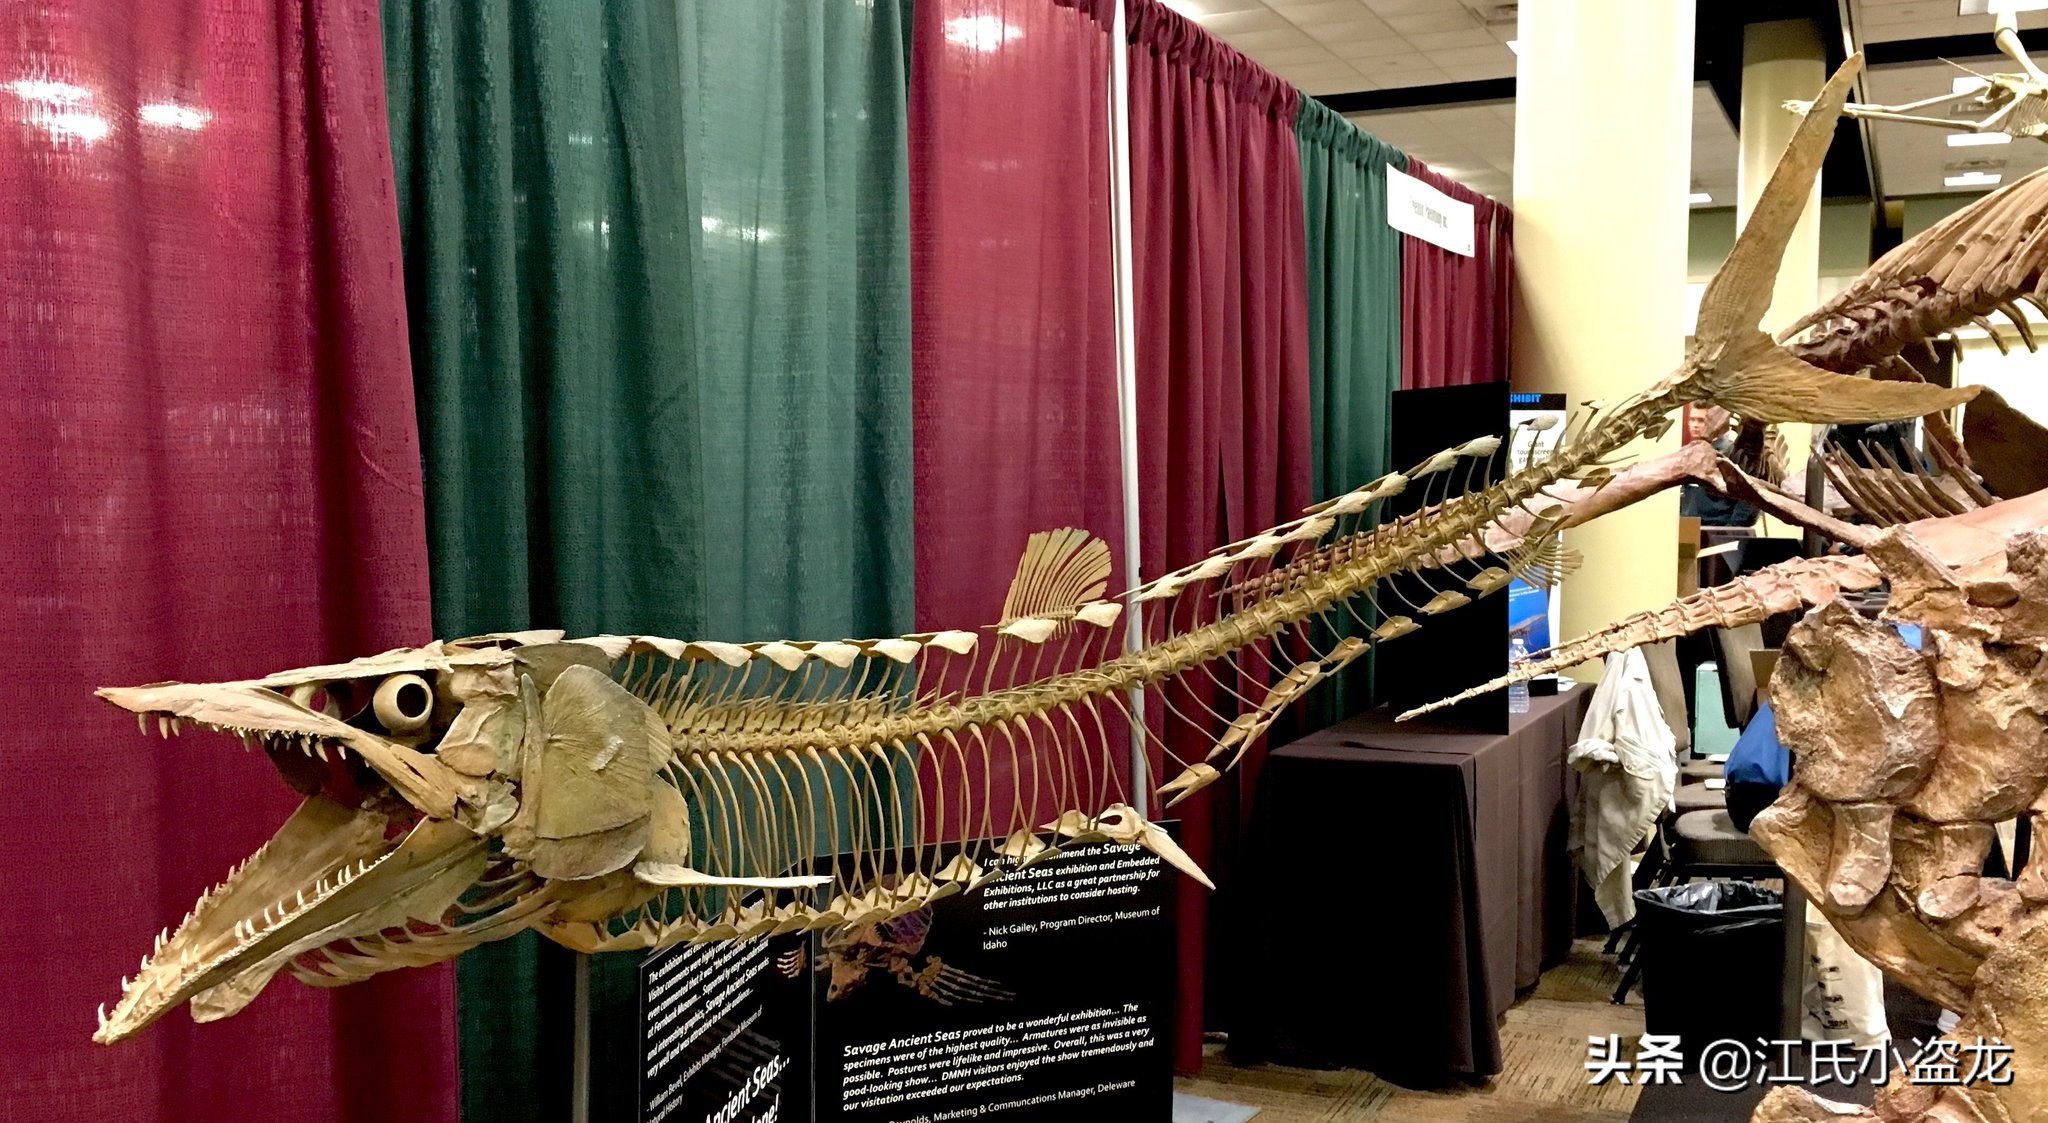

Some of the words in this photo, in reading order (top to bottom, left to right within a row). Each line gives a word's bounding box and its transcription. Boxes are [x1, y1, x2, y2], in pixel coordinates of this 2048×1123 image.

[984, 858, 988, 867] I
[1087, 846, 1101, 856] the
[1027, 868, 1053, 879] Seas
[1055, 863, 1097, 875] exhibition
[1099, 860, 1115, 871] and
[1116, 856, 1160, 869] Embedded
[983, 884, 1034, 898] Exhibitions,
[1036, 882, 1054, 891] LLC
[1055, 880, 1066, 888] as
[1066, 879, 1073, 888] a
[1073, 876, 1097, 889] great
[1097, 872, 1147, 886] partnership
[1146, 869, 1160, 881] for
[983, 901, 1008, 911] other
[1008, 894, 1058, 907] institutions
[1059, 893, 1069, 901] to
[1070, 889, 1106, 900] consider
[1107, 884, 1140, 896] hosting.
[988, 926, 1008, 936] Nick
[1009, 923, 1038, 934] Gailey,
[1040, 918, 1077, 931] Program
[1078, 914, 1113, 925] Director,
[1115, 910, 1150, 920] Museum
[1151, 906, 1161, 916] of
[649, 971, 658, 985] The
[659, 955, 682, 978] exhibition
[683, 948, 692, 960] was
[983, 939, 1008, 950] Idaho
[648, 985, 665, 1003] Visitor
[665, 966, 690, 990] comments
[690, 957, 701, 972] were
[702, 946, 716, 964] highly
[648, 1005, 661, 1021] even
[660, 980, 689, 1011] commented
[688, 974, 699, 990] that
[704, 966, 713, 978] was
[723, 950, 733, 964] best
[647, 1025, 654, 1039] at
[654, 1007, 678, 1034] Fernbank
[702, 969, 725, 996] Supported
[724, 967, 731, 980] by
[647, 1043, 658, 1061] and
[658, 1025, 684, 1052] interesting
[705, 990, 726, 1014] Savage
[725, 973, 746, 997] Ancient
[745, 965, 758, 982] Seas
[758, 955, 769, 972] works
[647, 1063, 658, 1079] very
[659, 1050, 670, 1069] well
[670, 1042, 680, 1060] and
[680, 1037, 690, 1051] was
[690, 1019, 712, 1043] attractive
[721, 1002, 732, 1017] wide
[843, 1041, 887, 1057] Savage
[888, 1034, 933, 1050] Ancient
[934, 1030, 961, 1043] Seas
[962, 1024, 994, 1040] proved
[995, 1024, 1004, 1032] to
[1006, 1020, 1017, 1031] be
[1026, 1013, 1069, 1027] wonderful
[1070, 1007, 1120, 1021] exhibition...
[1123, 1003, 1139, 1013] The
[843, 1056, 891, 1072] specimens
[893, 1053, 915, 1062] were
[916, 1050, 927, 1061] of
[928, 1046, 943, 1056] the
[945, 1042, 978, 1055] highest
[979, 1035, 1019, 1048] quality...
[1022, 1027, 1067, 1042] Armatures
[1069, 1024, 1090, 1033] were
[1091, 1022, 1101, 1031] as
[1102, 1017, 1136, 1029] invisible
[1137, 1015, 1147, 1023] as
[649, 1090, 669, 1111] William
[683, 1060, 702, 1082] Exhibits
[721, 1024, 741, 1048] Fernbank
[740, 1012, 758, 1032] Museum
[752, 1054, 790, 1098] Seas...
[843, 1070, 883, 1087] possible.
[888, 1063, 927, 1076] Postures
[928, 1060, 951, 1070] were
[952, 1053, 983, 1068] lifelike
[983, 1049, 1001, 1061] and
[1002, 1043, 1050, 1058] impressive.
[1053, 1036, 1087, 1049] Overall,
[1089, 1033, 1105, 1044] this
[1106, 1031, 1123, 1041] was
[1131, 1027, 1150, 1037] very
[843, 1080, 903, 1101] good-looking
[904, 1076, 937, 1088] show...
[941, 1068, 972, 1081] DMNH
[973, 1064, 1005, 1076] visitors
[1006, 1056, 1040, 1071] enjoyed
[1041, 1054, 1056, 1064] the
[1057, 1051, 1080, 1062] show
[1081, 1042, 1137, 1058] tremendously
[1138, 1037, 1155, 1048] and
[665, 1093, 683, 1115] History
[843, 1102, 860, 1111] our
[861, 1094, 904, 1108] visitation
[906, 1085, 948, 1100] exceeded
[949, 1083, 965, 1093] our
[966, 1074, 1024, 1091] expectations.
[933, 1107, 978, 1122] Marketing
[979, 1104, 987, 1114] &
[987, 1094, 1056, 1112] Communcations
[1057, 1087, 1096, 1099] Manager,
[1097, 1079, 1136, 1093] Deleware
